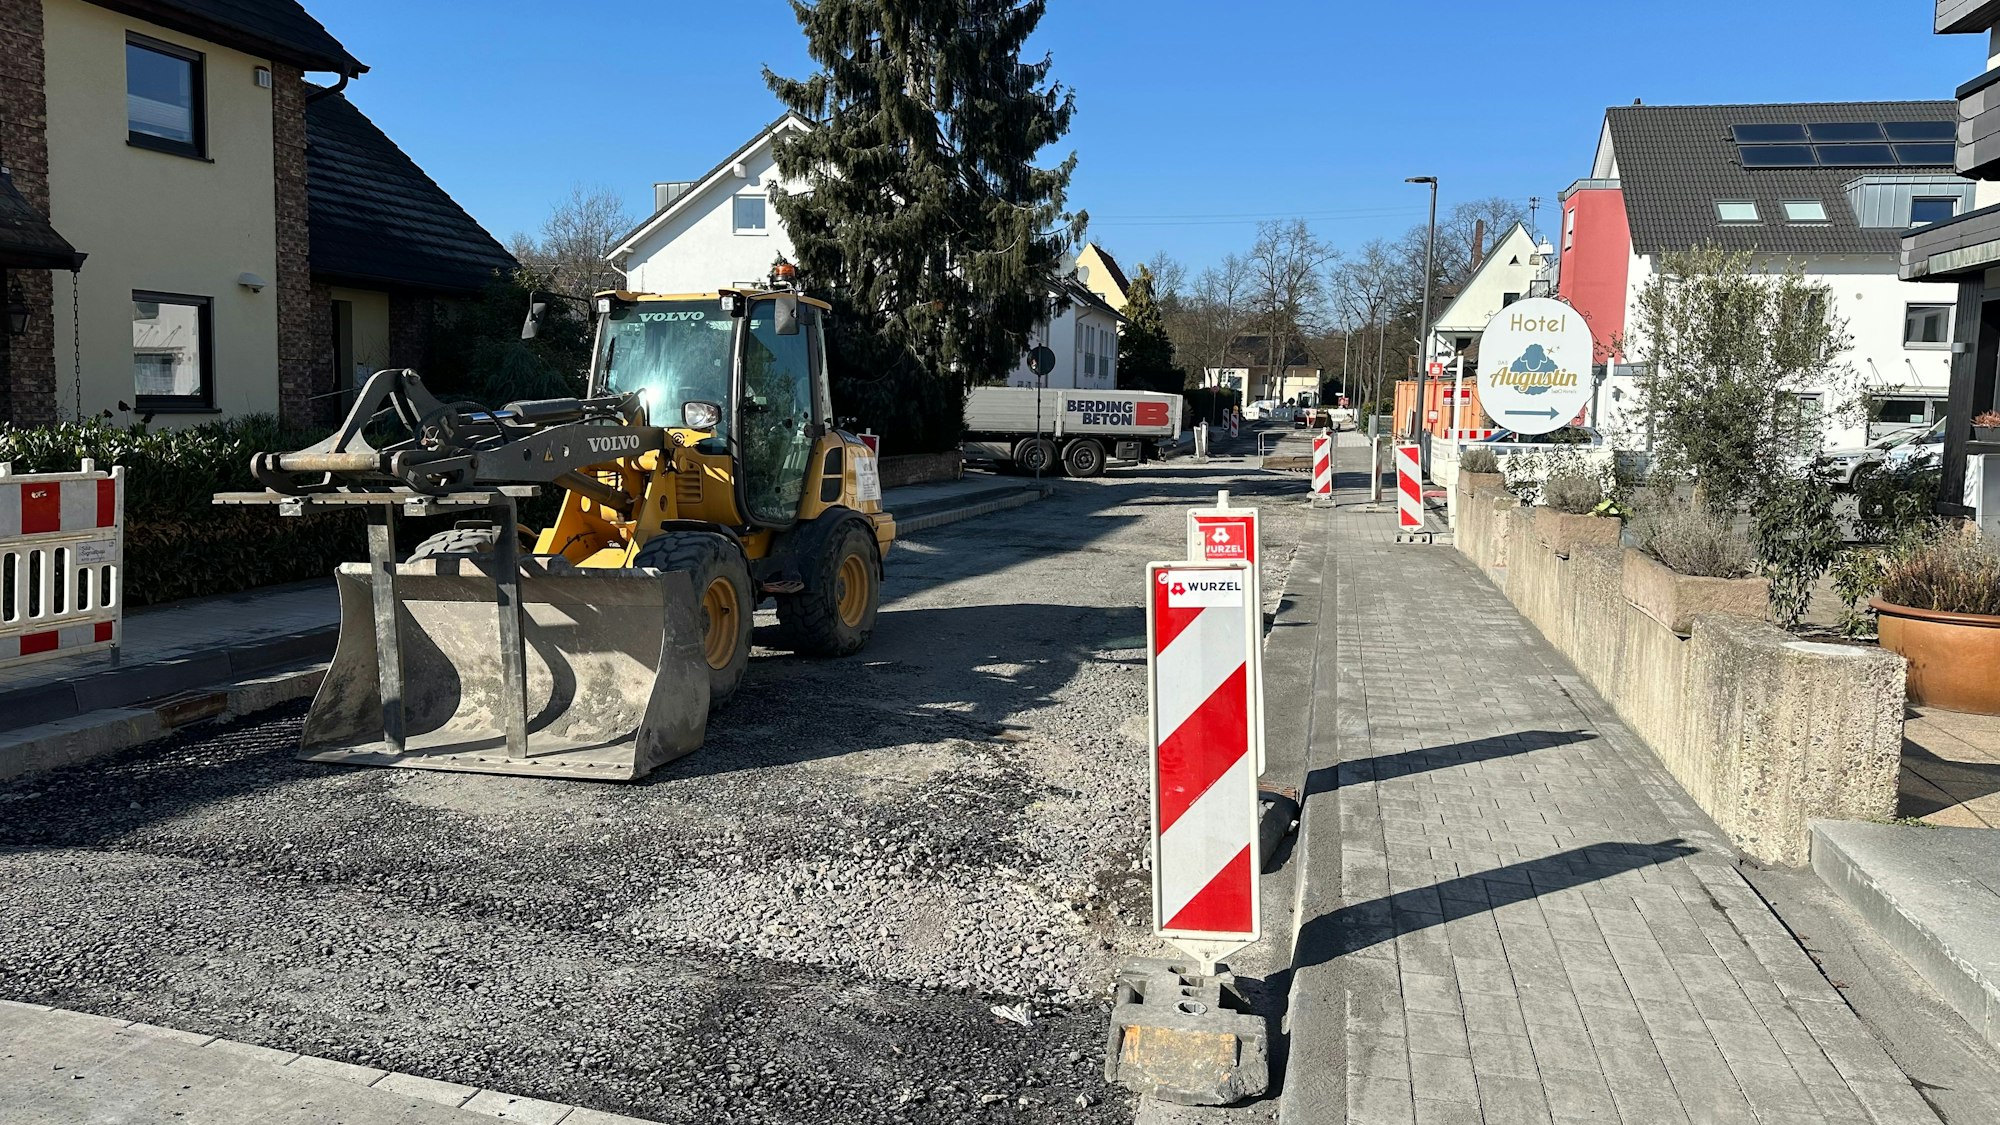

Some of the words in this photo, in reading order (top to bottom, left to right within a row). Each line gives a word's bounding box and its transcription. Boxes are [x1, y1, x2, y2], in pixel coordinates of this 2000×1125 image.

[638, 311, 705, 322] VOLVO
[1510, 313, 1566, 333] Hotel
[1489, 366, 1578, 392] Augustin
[1066, 399, 1134, 414] BERDING
[1135, 401, 1170, 427] B
[1082, 412, 1133, 426] BETON
[587, 434, 640, 453] VOLVO
[1188, 581, 1242, 592] WURZEL
